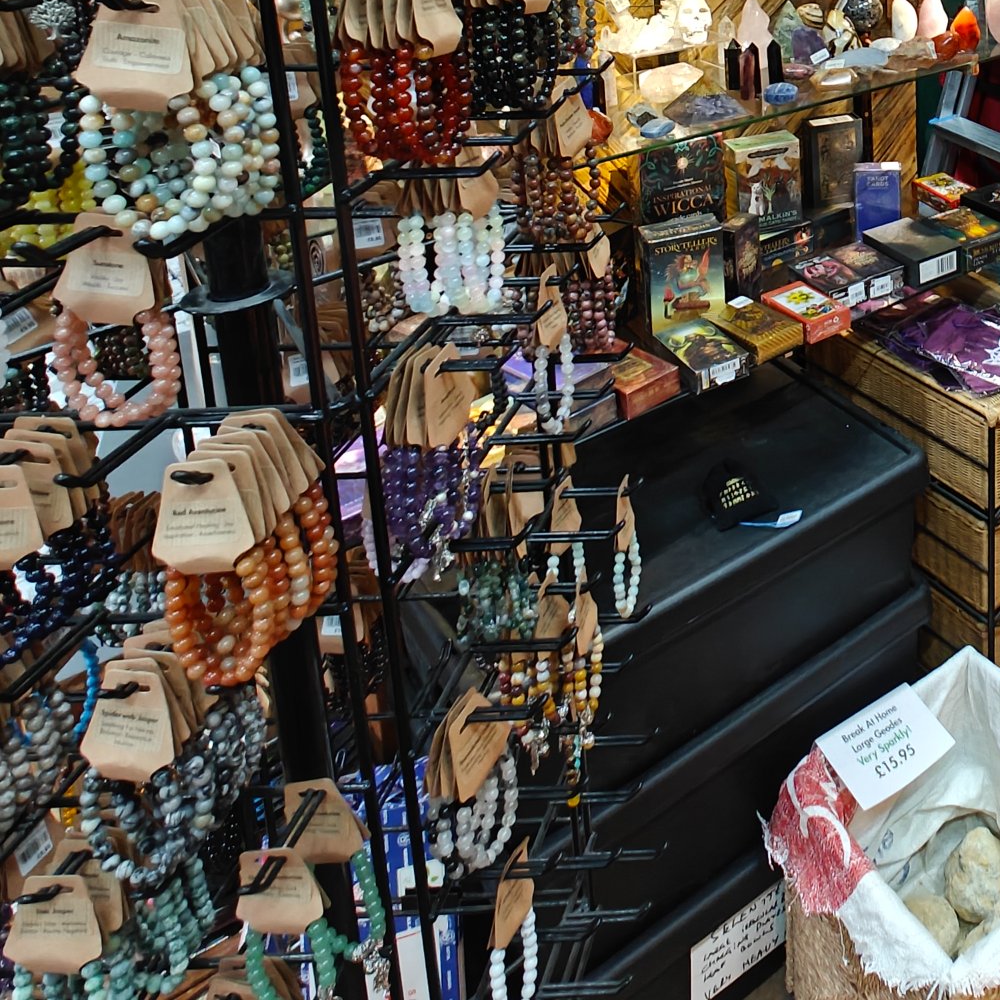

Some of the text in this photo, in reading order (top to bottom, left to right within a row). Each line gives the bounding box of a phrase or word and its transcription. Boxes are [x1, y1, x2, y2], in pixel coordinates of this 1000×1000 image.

[653, 184, 712, 203] INSPIRATIONAL
[653, 193, 714, 217] WICCA
[841, 704, 898, 744] Break At Home
[851, 717, 903, 754] Large Geodes
[856, 724, 913, 767] Very Sparkly!
[874, 743, 916, 779] £15.95
[742, 935, 779, 971] HEAVY
